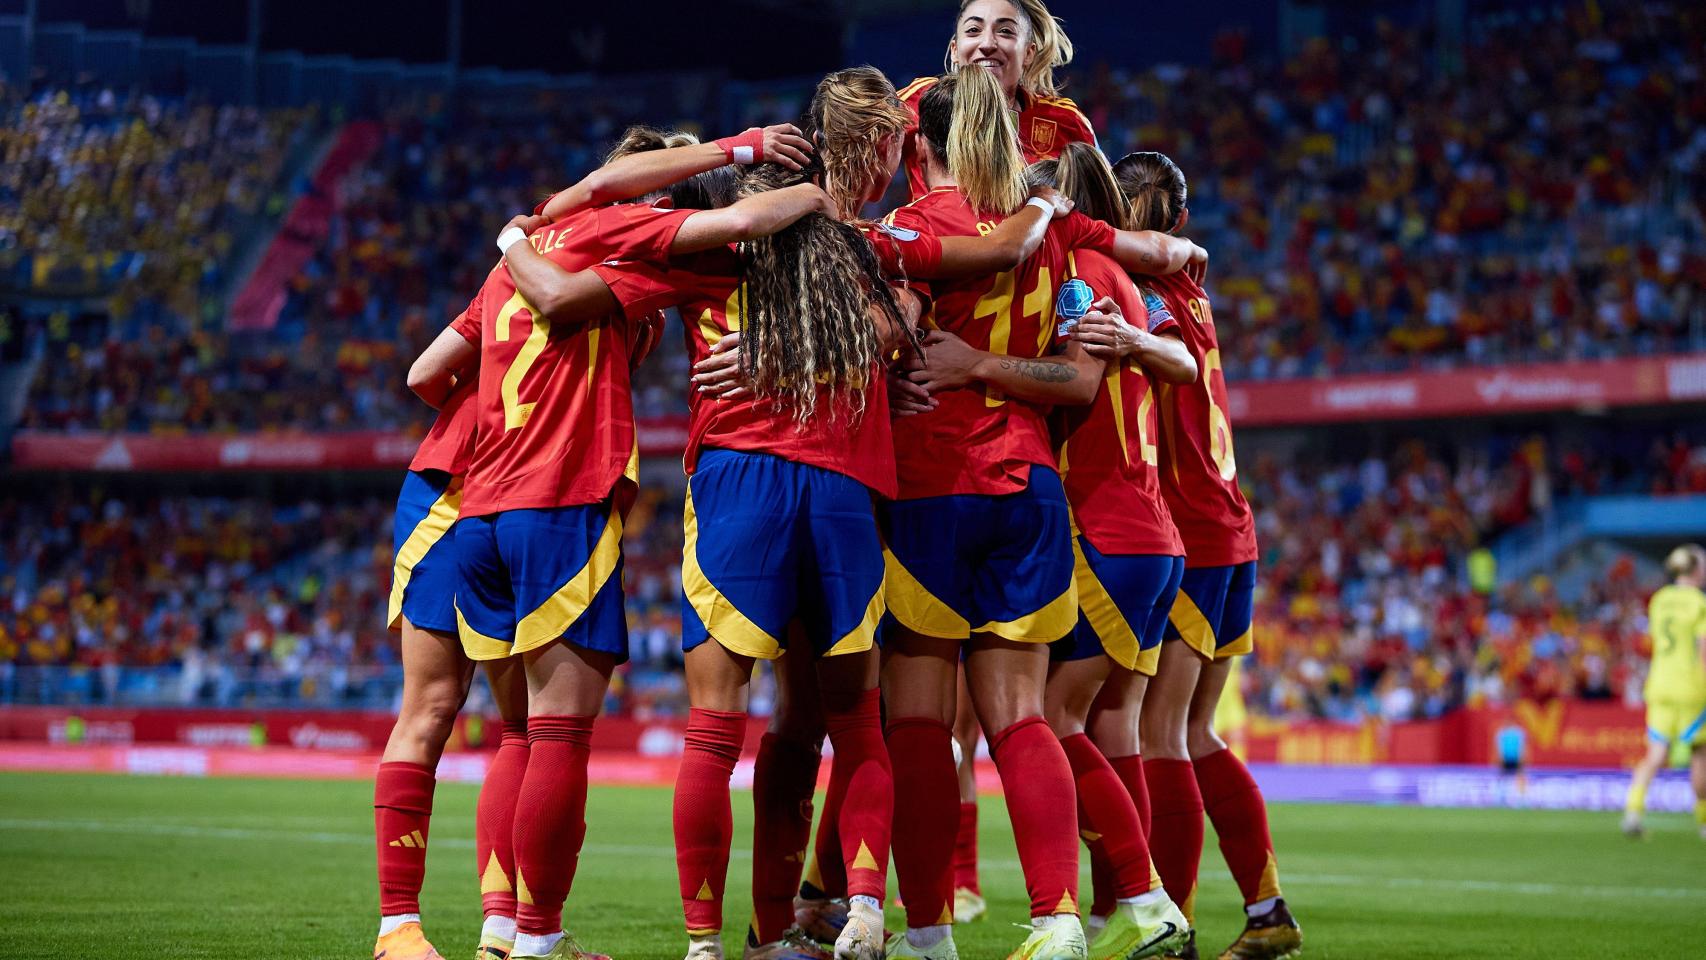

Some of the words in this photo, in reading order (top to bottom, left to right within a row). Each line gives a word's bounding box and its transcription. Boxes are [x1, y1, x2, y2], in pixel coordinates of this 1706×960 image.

[495, 286, 551, 434] 2
[973, 266, 1053, 408] 11
[1203, 348, 1237, 482] 6
